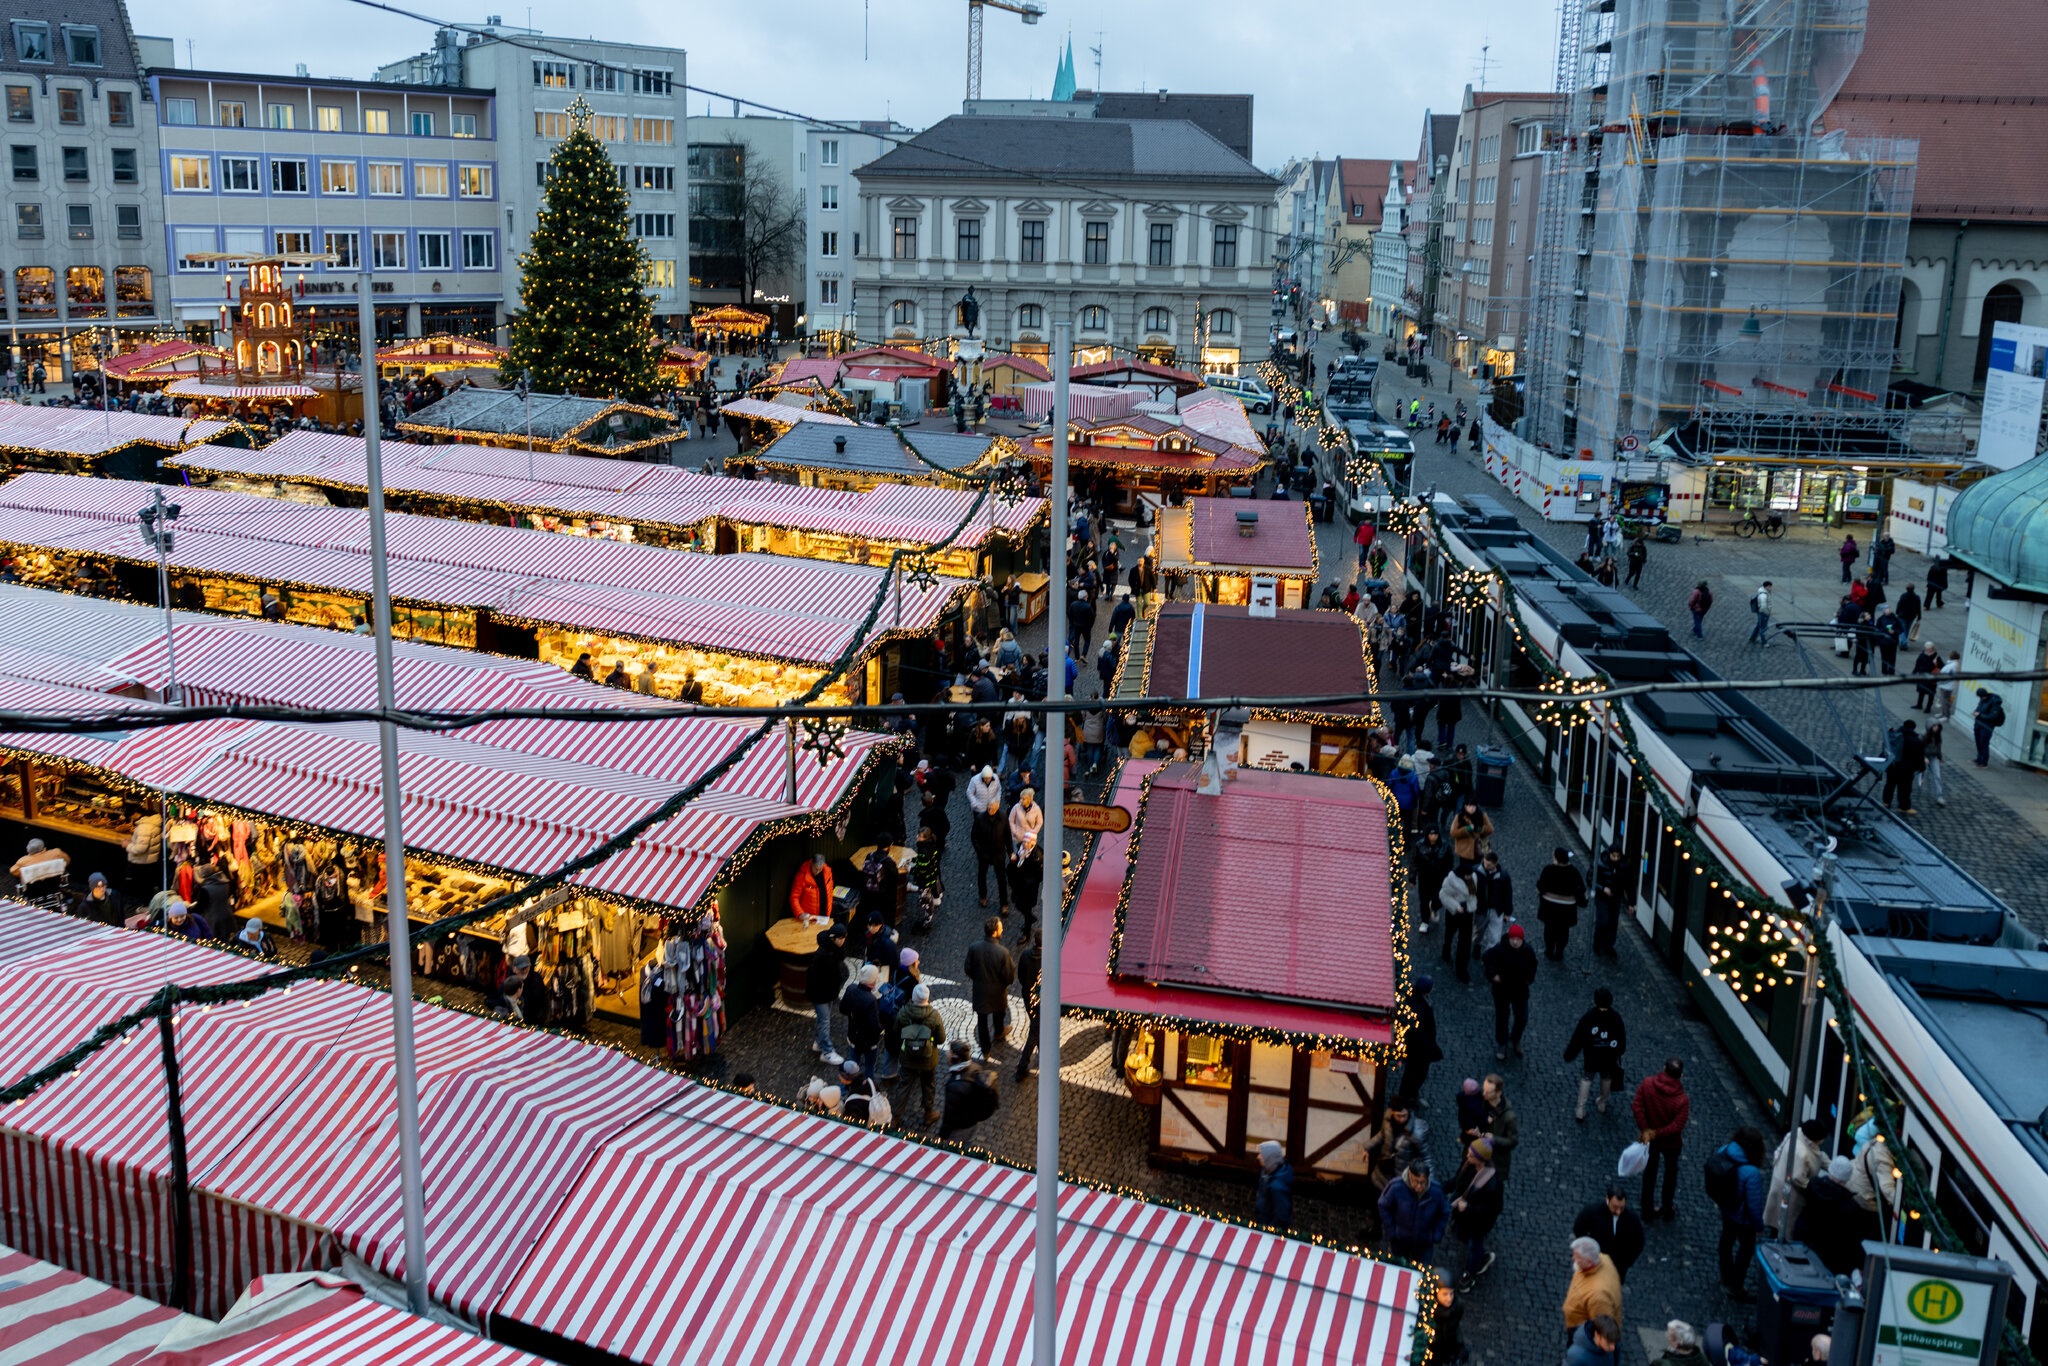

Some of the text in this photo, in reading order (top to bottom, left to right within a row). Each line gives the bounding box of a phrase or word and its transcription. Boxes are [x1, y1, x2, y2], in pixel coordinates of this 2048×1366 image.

[295, 280, 394, 293] HENRY'S CFEE
[1063, 807, 1110, 821] MARWIN'S
[1922, 1287, 1949, 1316] H
